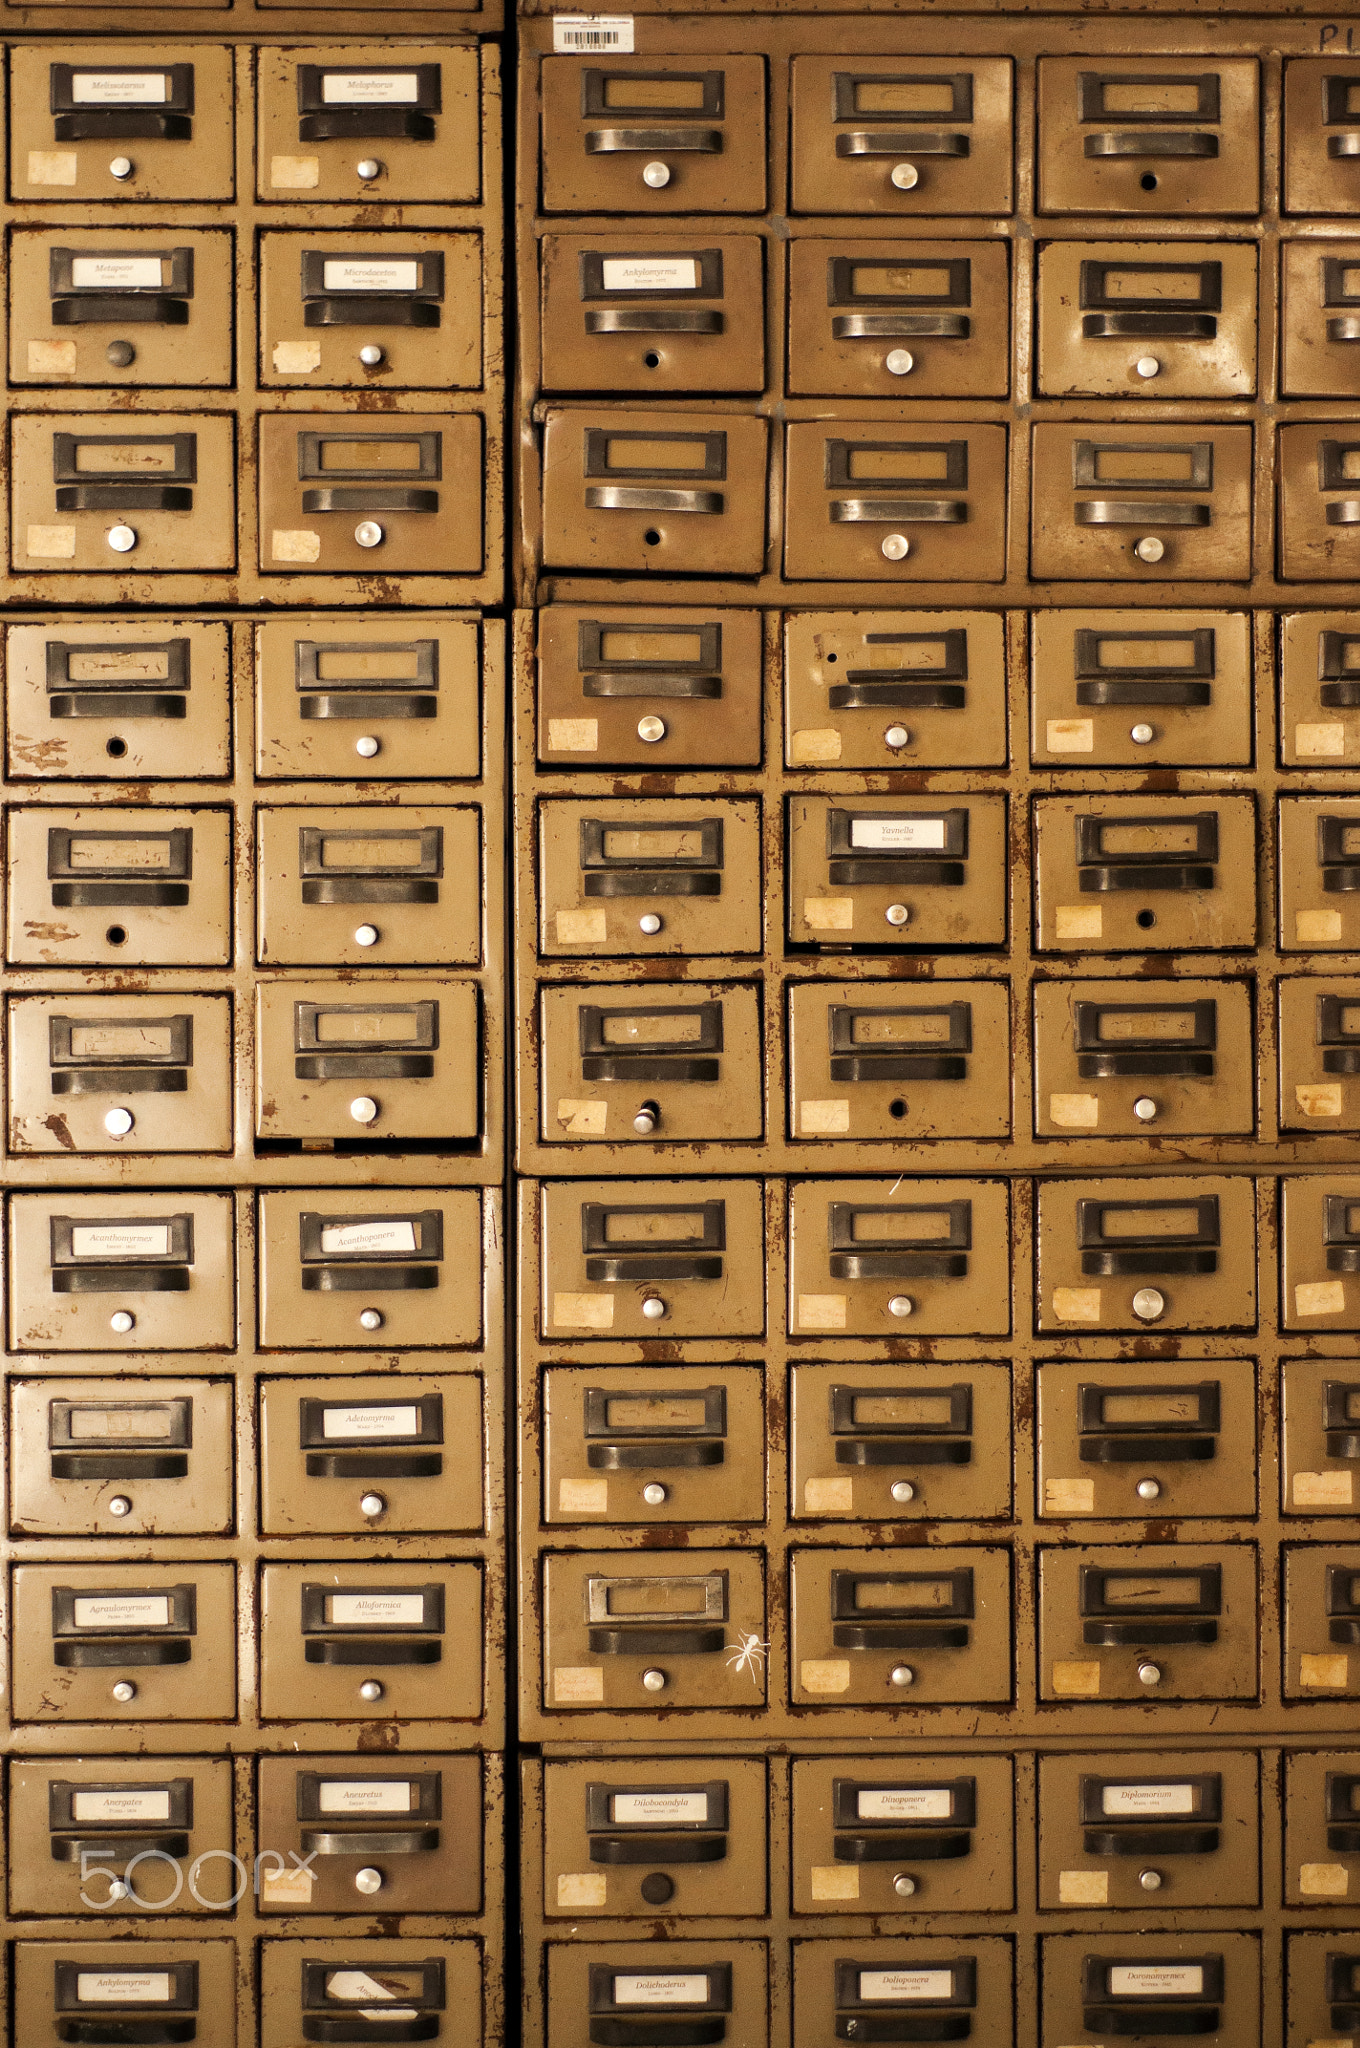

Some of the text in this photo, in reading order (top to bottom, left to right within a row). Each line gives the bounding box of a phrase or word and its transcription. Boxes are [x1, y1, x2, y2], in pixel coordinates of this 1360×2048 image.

[347, 81, 393, 90] Melophorus
[623, 268, 677, 278] Ankylomyrma
[882, 826, 914, 834] Yavnella
[90, 1234, 152, 1244] Acanthomyrmex
[338, 1231, 395, 1246] Acanthoponera
[346, 1414, 395, 1423] Adetomyrma
[90, 1604, 151, 1614] Agraulomyrmex
[356, 1600, 401, 1610] Alloformica
[343, 1791, 383, 1799] Aneuretus
[881, 1795, 926, 1804] Dinoponera
[1121, 1790, 1172, 1800] Diplomorium
[103, 1799, 142, 1807] Anergates
[633, 1798, 689, 1808] Dilobocondyla
[96, 1979, 151, 1988] Ankylomyrma
[635, 1981, 686, 1989] Dolichoderus
[882, 1976, 930, 1985] Dolioponera
